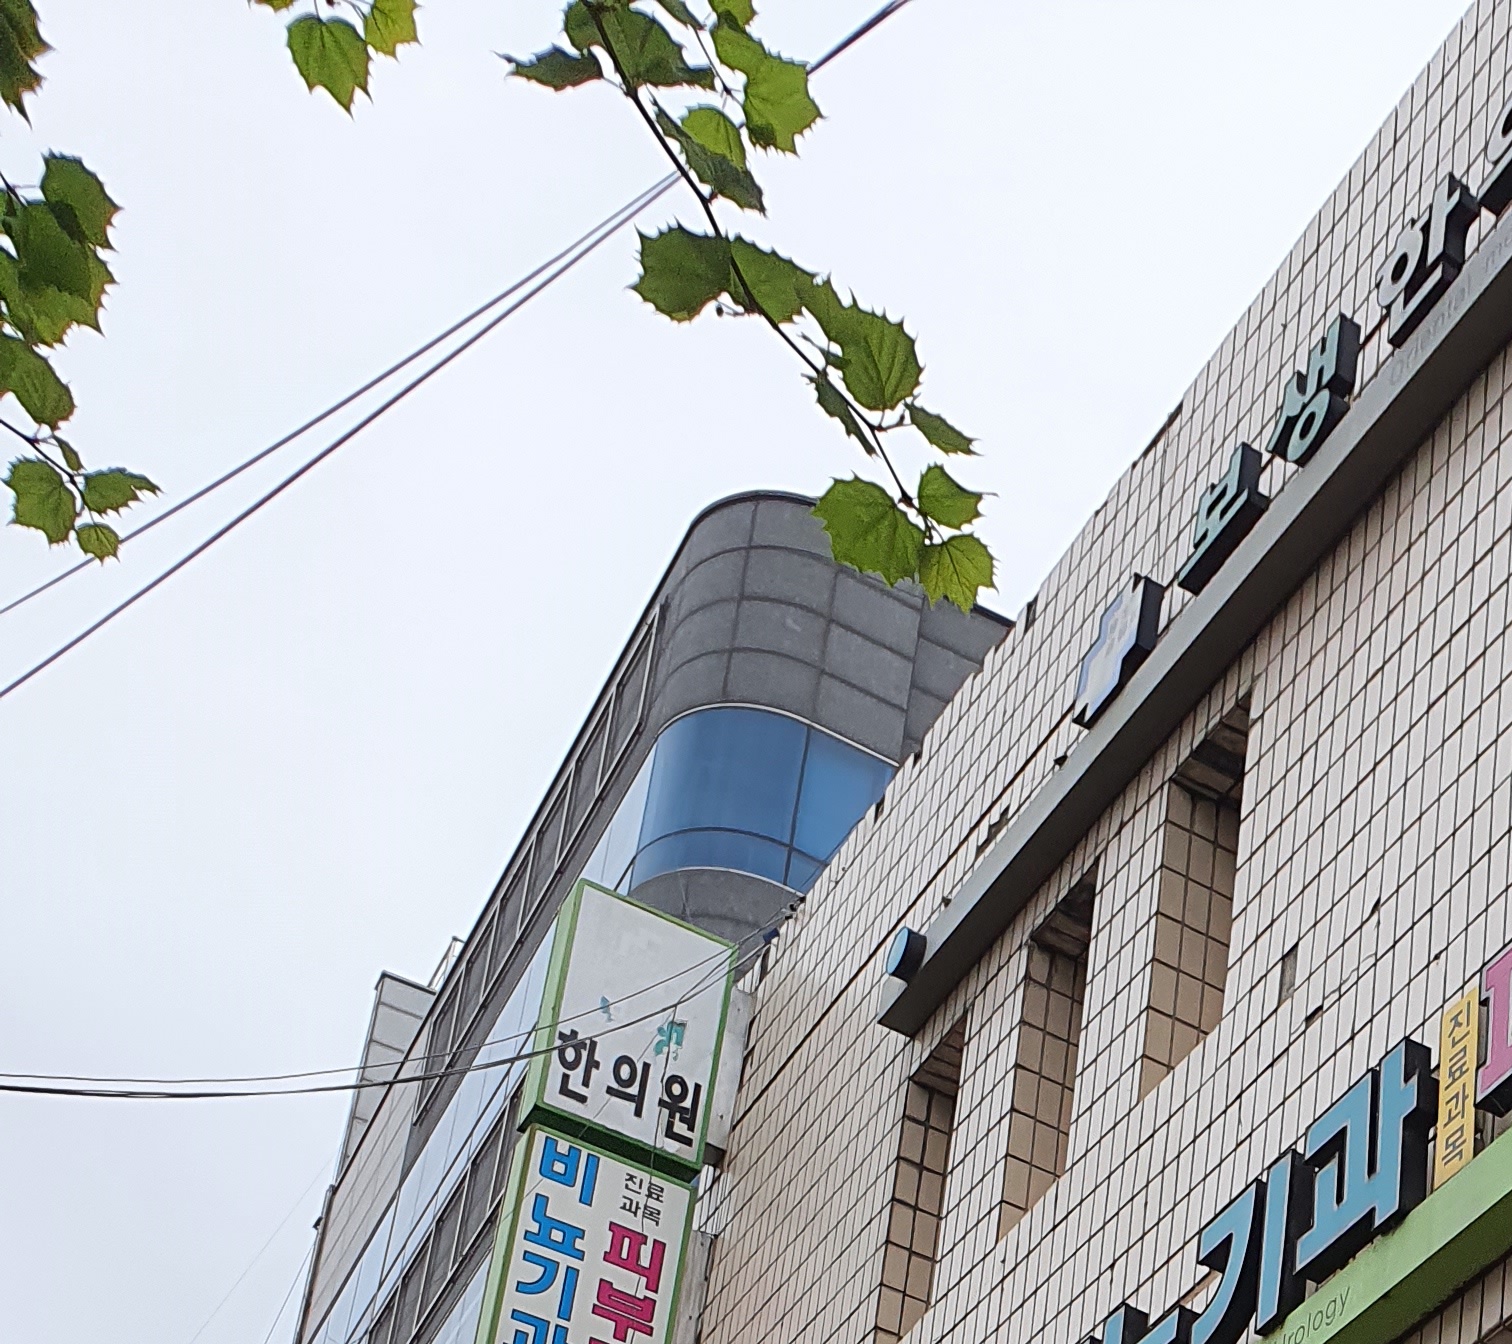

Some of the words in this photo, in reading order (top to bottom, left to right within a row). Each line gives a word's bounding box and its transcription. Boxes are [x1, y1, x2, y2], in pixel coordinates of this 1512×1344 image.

[556, 1028, 703, 1148] 한의원
[1440, 1008, 1475, 1170] 진료과목
[620, 1195, 661, 1226] 과목
[624, 1172, 665, 1205] 진료
